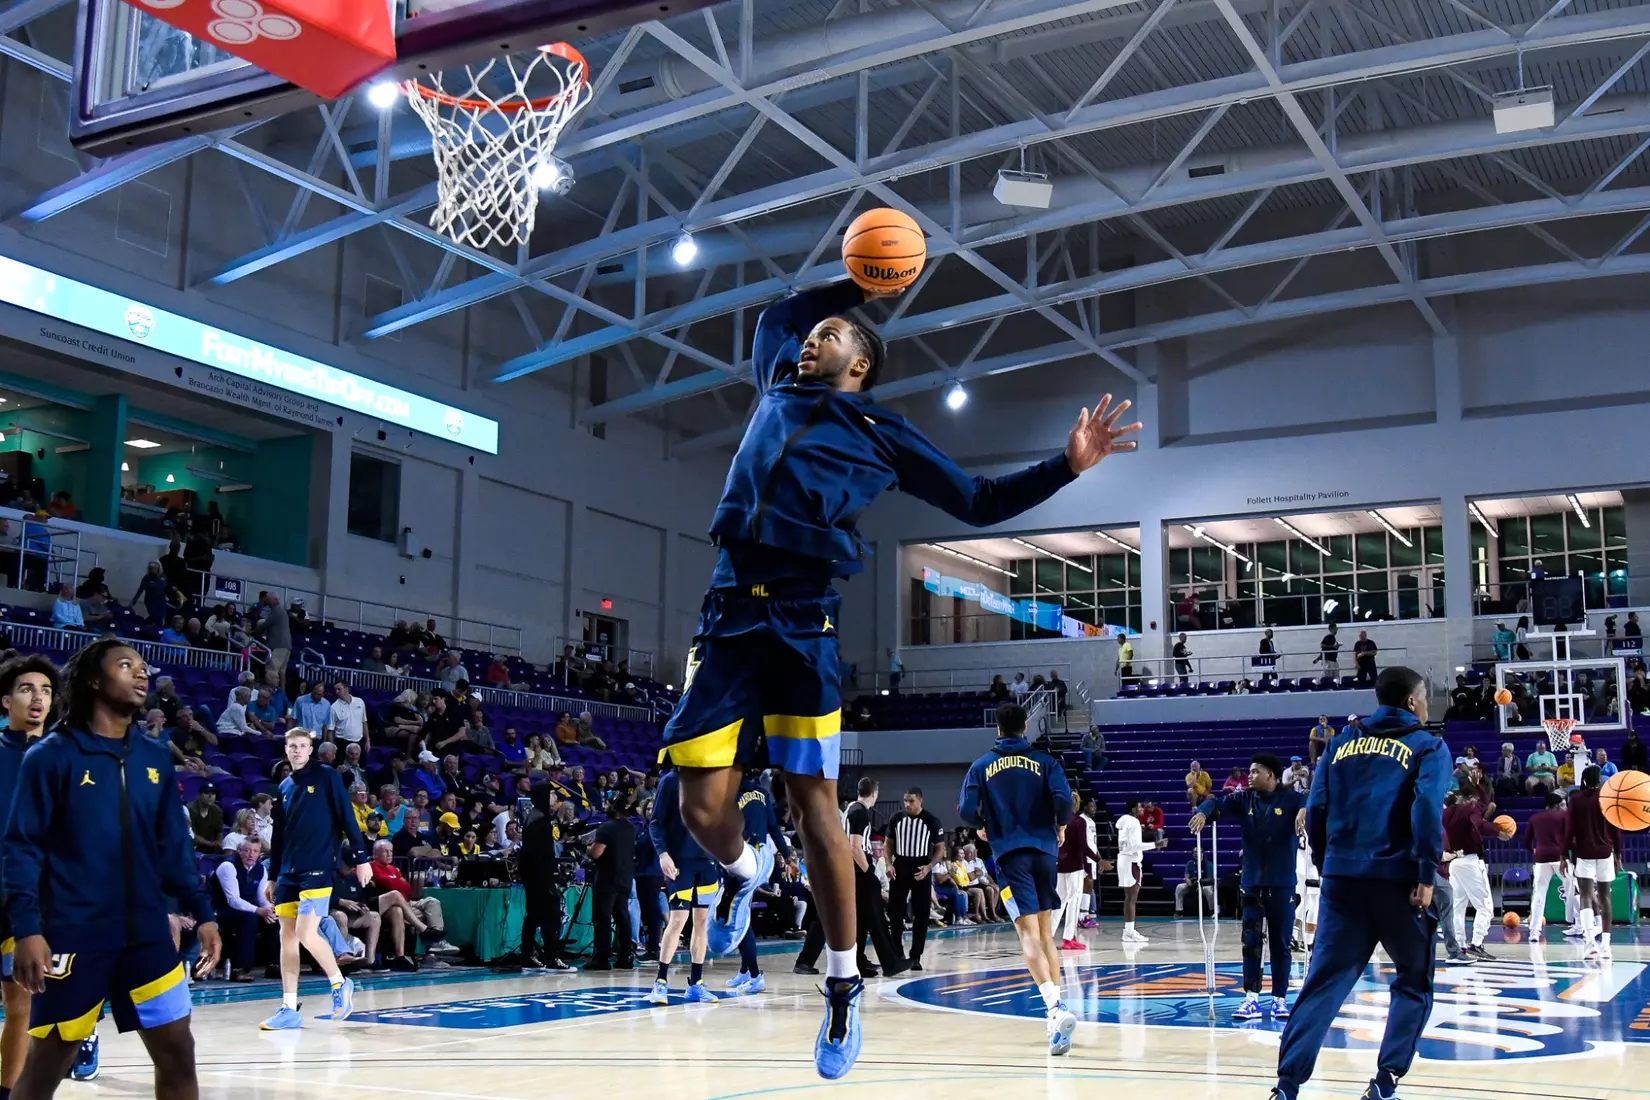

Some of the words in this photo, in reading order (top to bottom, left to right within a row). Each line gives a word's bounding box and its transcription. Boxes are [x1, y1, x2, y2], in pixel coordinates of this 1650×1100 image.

[863, 264, 917, 280] Wilson
[40, 328, 80, 347] Suncoast
[82, 340, 108, 356] Credit
[111, 349, 136, 363] Union
[188, 377, 224, 395] Brancazio
[225, 388, 250, 402] Wealth
[283, 406, 314, 421] Raymond
[315, 415, 334, 427] James
[208, 372, 225, 383] Arch
[225, 377, 252, 391] Capital
[253, 385, 281, 401] Advisory
[284, 395, 305, 408] Group
[306, 403, 319, 412] and
[1247, 497, 1272, 505] Follett
[1273, 493, 1316, 503] Hospitality
[1318, 490, 1349, 499] Pavilion
[225, 581, 237, 591] 108
[1622, 640, 1636, 648] 112
[1332, 736, 1413, 770] MARQUETTE
[985, 755, 1041, 782] MARQUETTE
